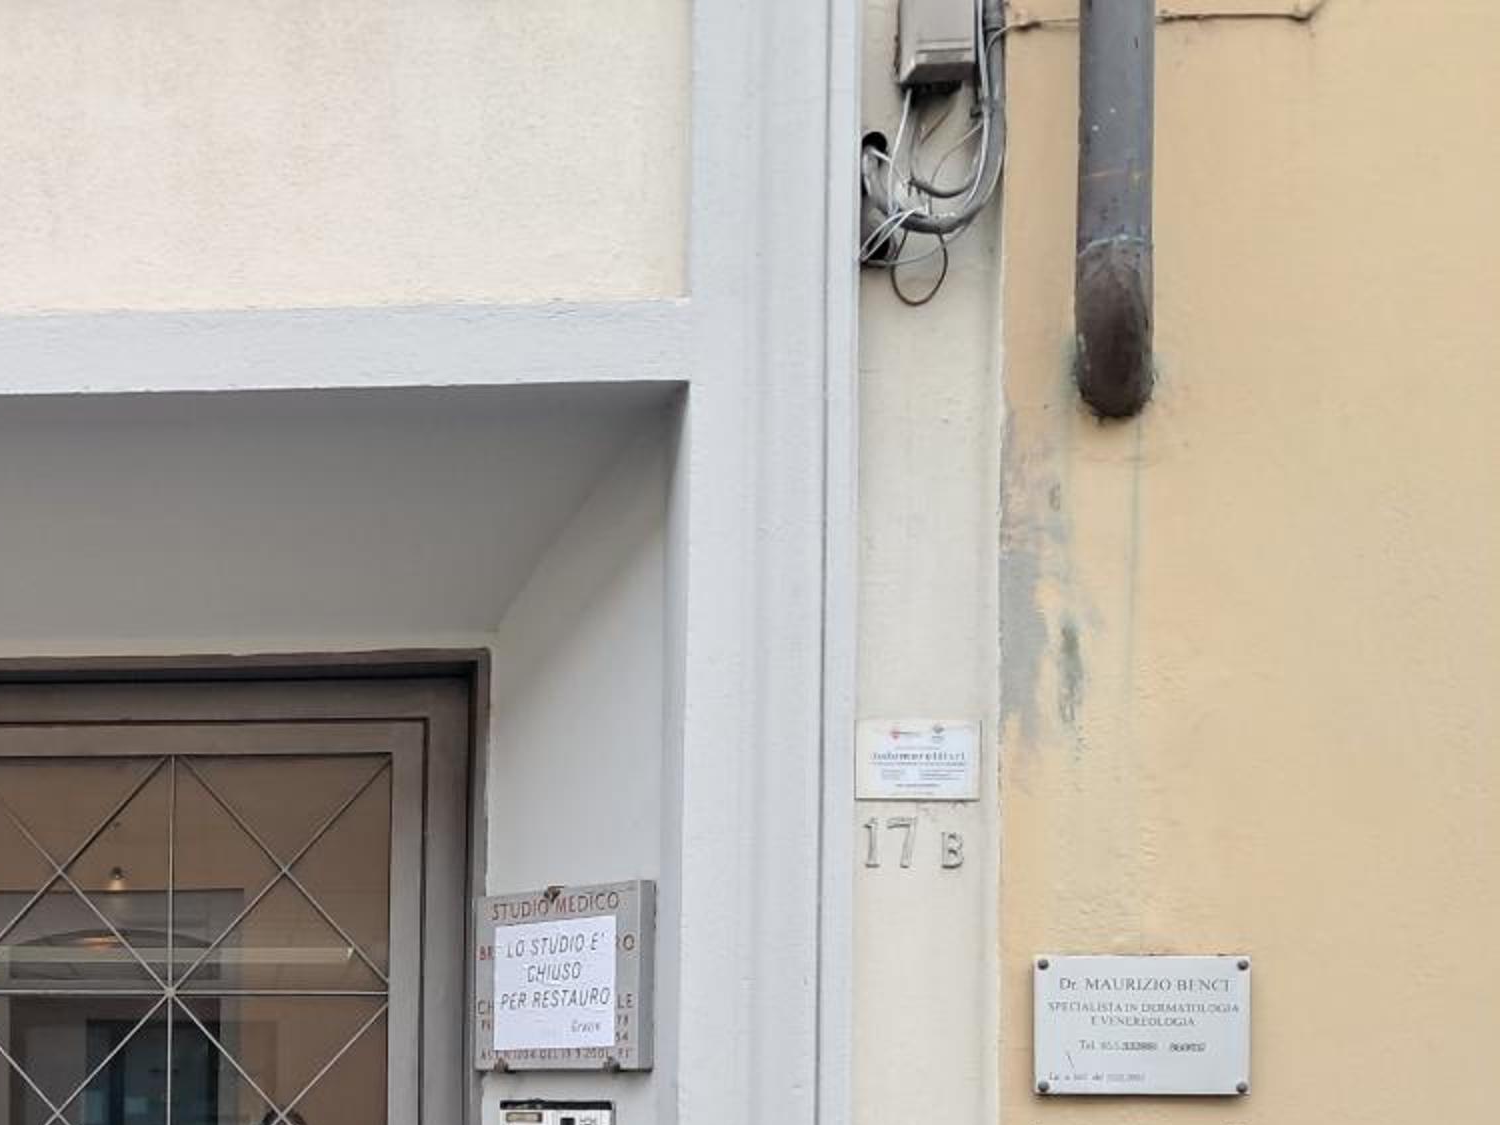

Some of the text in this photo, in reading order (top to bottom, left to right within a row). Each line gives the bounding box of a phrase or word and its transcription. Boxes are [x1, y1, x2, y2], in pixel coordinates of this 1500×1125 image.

[863, 816, 964, 869] 17 B
[492, 891, 620, 922] STUDIO MEDICO
[506, 939, 525, 959] LO
[530, 933, 585, 956] STUDIO
[591, 931, 605, 951] E'
[527, 960, 582, 983] CHIUSO
[1085, 978, 1171, 992] MAURIZIO
[1177, 978, 1230, 992] BENCI
[501, 992, 527, 1010] PER
[532, 987, 611, 1009] RESTAURO
[1049, 1001, 1121, 1013] SPECIALISTA
[1141, 1003, 1239, 1013] DERMATOLOGIA
[1101, 1016, 1196, 1027] VENEREOLOGIA
